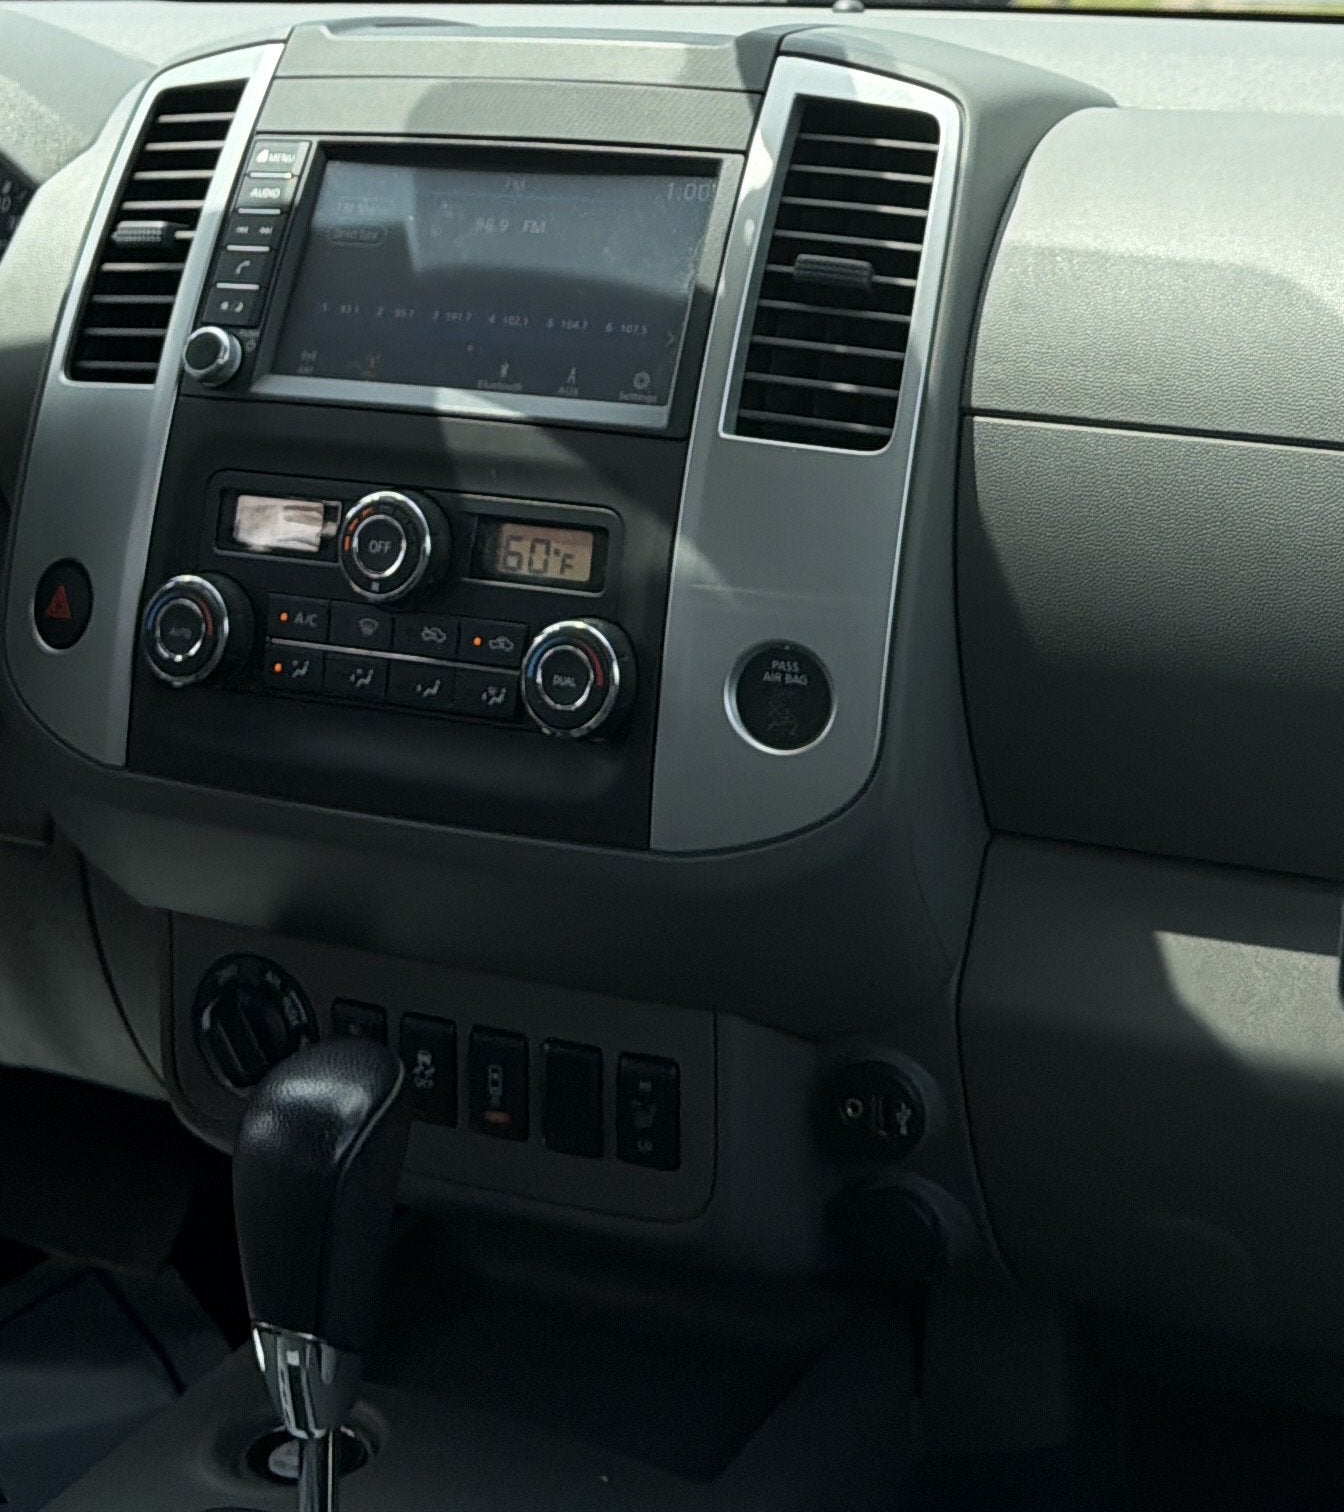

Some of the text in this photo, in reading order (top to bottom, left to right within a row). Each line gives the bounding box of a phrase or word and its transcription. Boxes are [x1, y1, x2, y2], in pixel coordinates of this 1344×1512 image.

[268, 151, 296, 164] MENU
[249, 187, 281, 200] AUDIO
[368, 539, 392, 554] OFF
[293, 611, 318, 628] A/C
[771, 657, 801, 674] PASS
[552, 673, 577, 689] DUAL
[762, 669, 809, 687] AIR BAG
